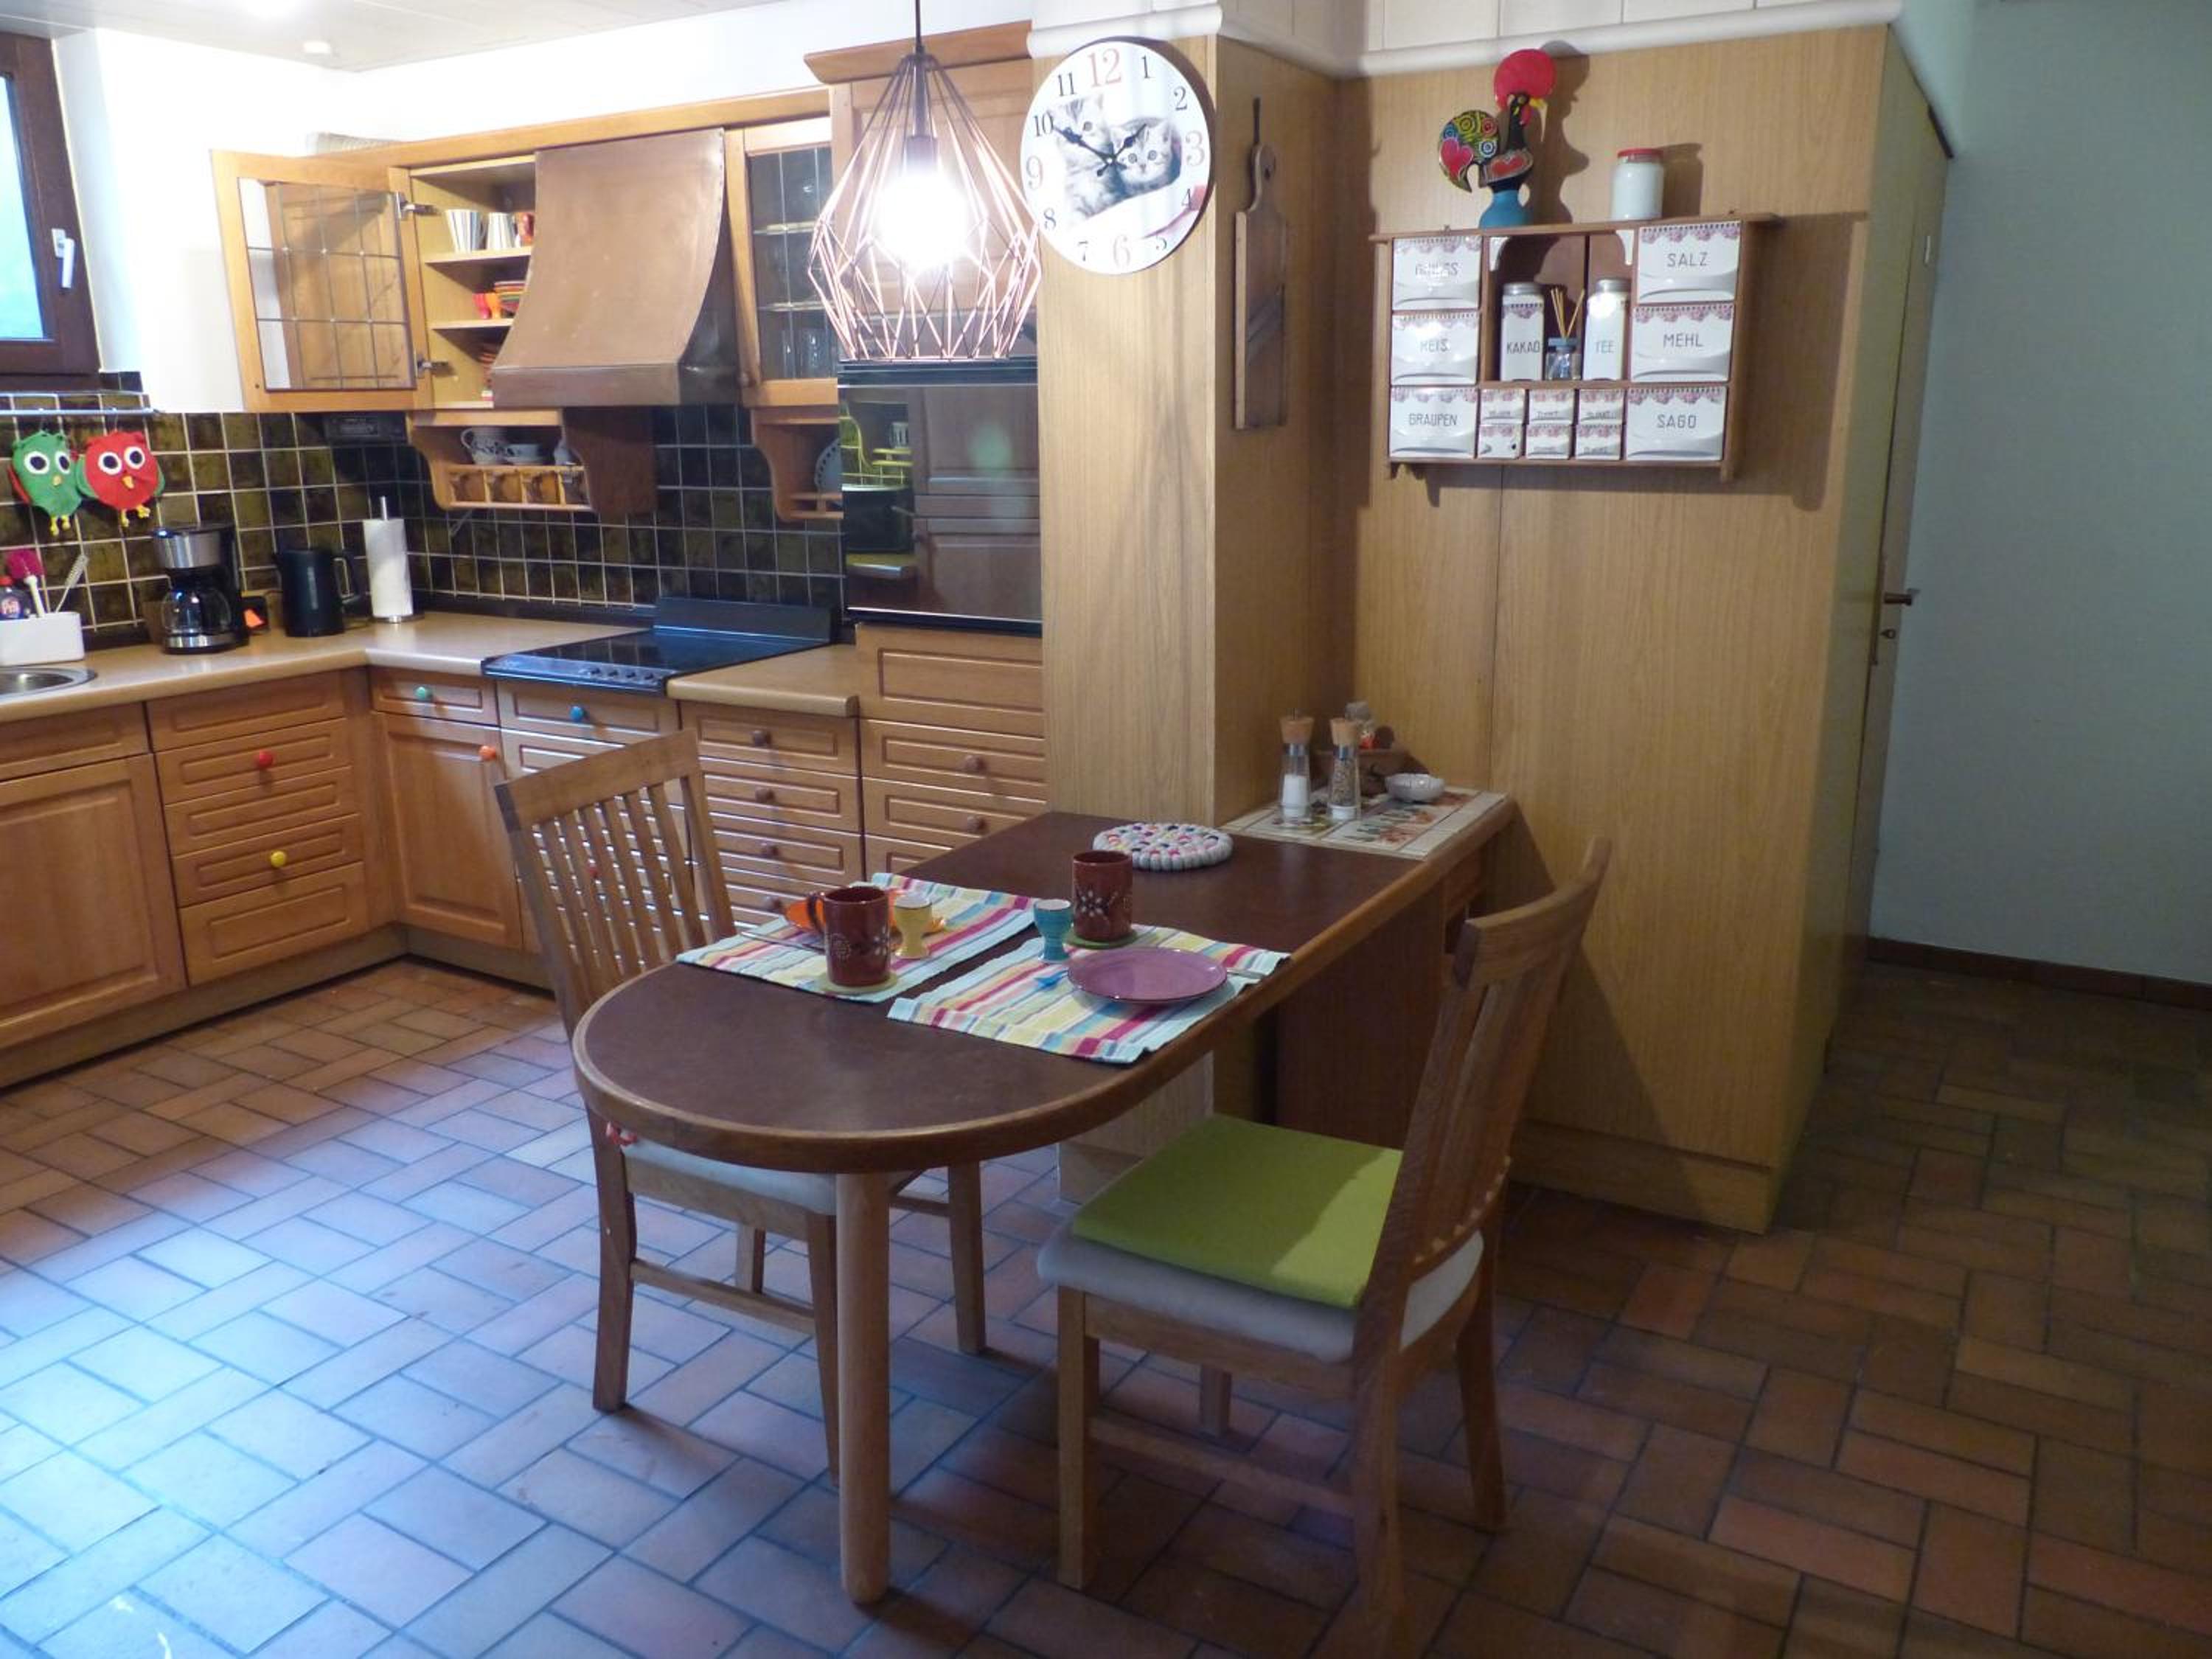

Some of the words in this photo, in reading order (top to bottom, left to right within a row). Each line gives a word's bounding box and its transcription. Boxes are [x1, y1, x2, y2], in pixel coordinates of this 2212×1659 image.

[1088, 49, 1121, 88] 12
[1141, 55, 1151, 79] 1
[1057, 72, 1077, 97] 11
[1173, 86, 1188, 111] 2
[1034, 113, 1054, 137] 10
[1186, 131, 1206, 167] 3
[1026, 155, 1043, 189] 9
[1181, 188, 1192, 210] 4
[1043, 207, 1057, 231] 8
[1112, 234, 1131, 268] 6
[1666, 251, 1708, 268] SALZ
[1506, 341, 1540, 355] KAKAO
[1595, 341, 1615, 354] TEE
[1663, 333, 1703, 349] MEHL
[1409, 412, 1458, 428] GRAUPEN
[1657, 414, 1697, 429] SAGO
